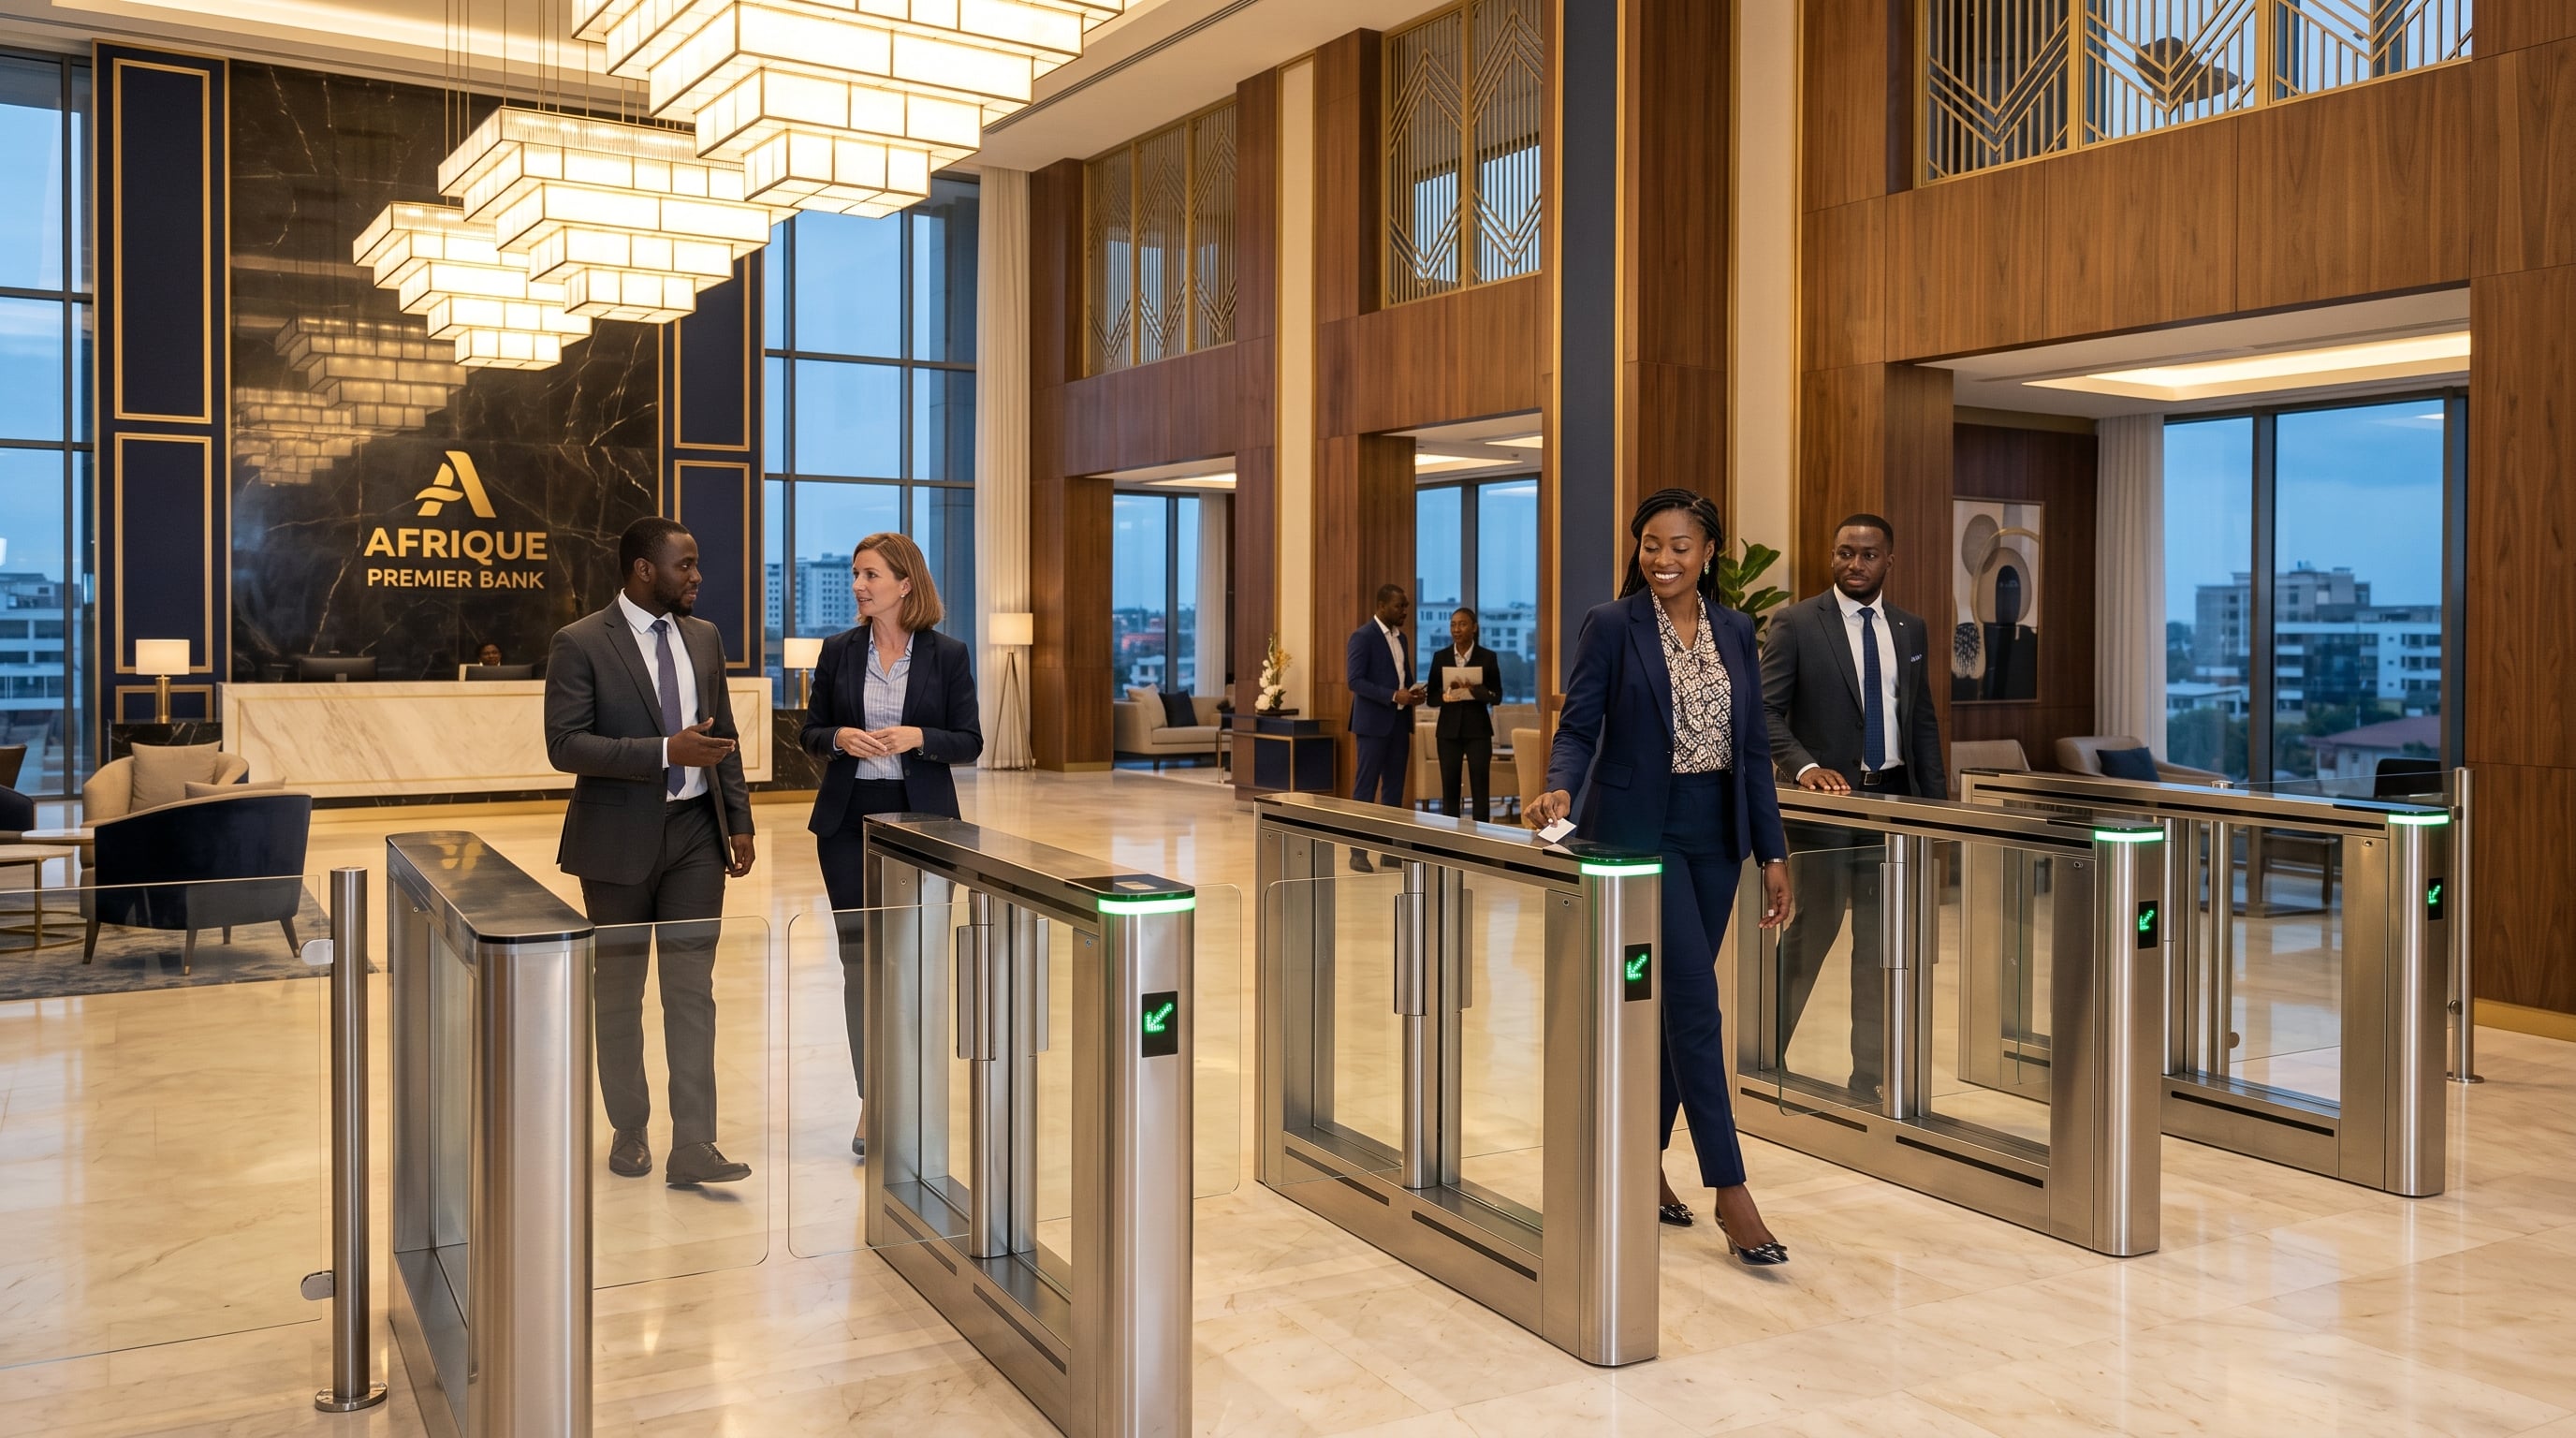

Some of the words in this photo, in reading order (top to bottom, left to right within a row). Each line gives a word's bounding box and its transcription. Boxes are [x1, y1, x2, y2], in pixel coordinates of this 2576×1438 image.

[363, 527, 548, 565] AFRIQUE
[367, 568, 472, 588] PREMIER
[480, 571, 544, 589] BANK
